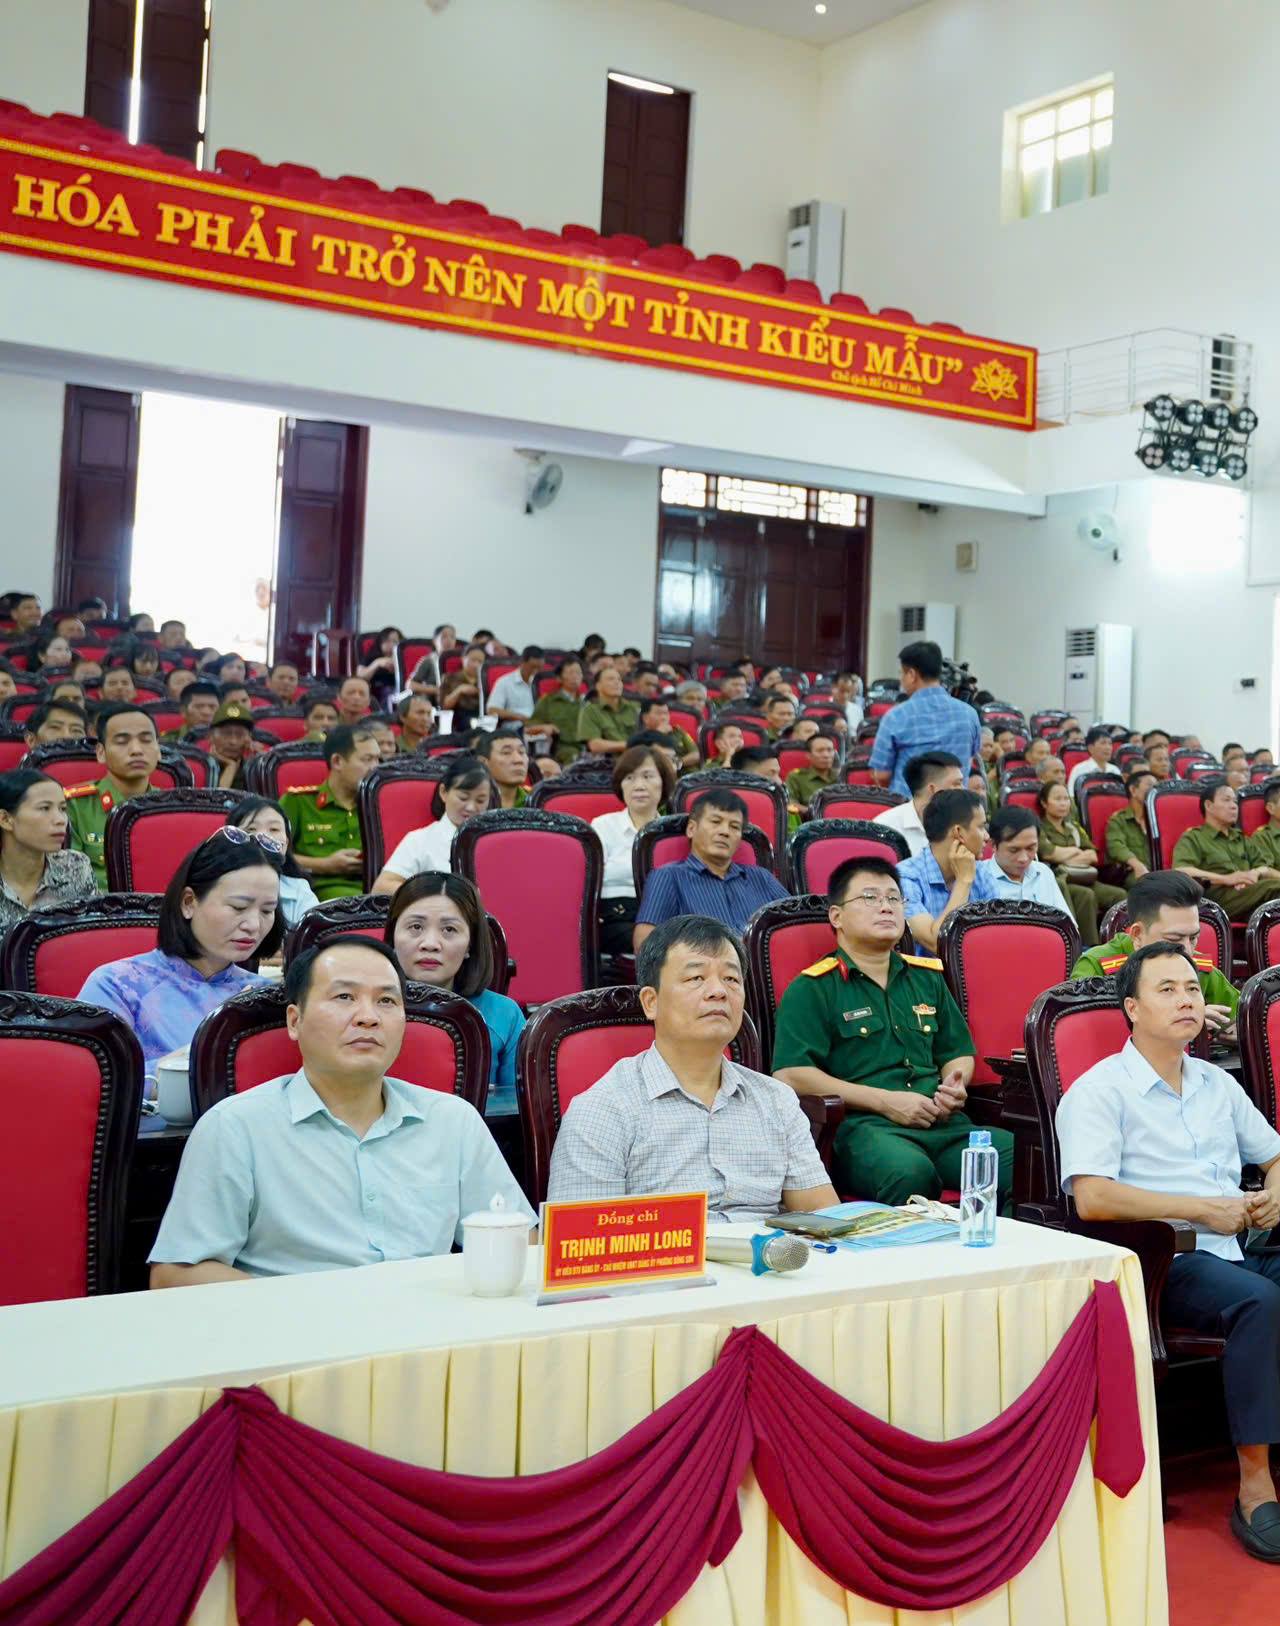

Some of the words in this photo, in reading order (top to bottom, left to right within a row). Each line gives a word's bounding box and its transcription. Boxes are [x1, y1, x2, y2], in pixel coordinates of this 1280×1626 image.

[12, 174, 140, 237] HÓA
[156, 204, 298, 267] PHẢI
[311, 235, 416, 288] TRỞ
[423, 254, 528, 309] NÊN
[536, 279, 636, 332] MỘT
[644, 290, 751, 351] TỈNH
[758, 315, 857, 370] KIỂU
[598, 1211, 634, 1226] Đồng
[637, 1210, 659, 1224] chí
[560, 1236, 606, 1261] TRỊNH
[609, 1232, 651, 1255] MINH
[653, 1228, 693, 1250] LONG
